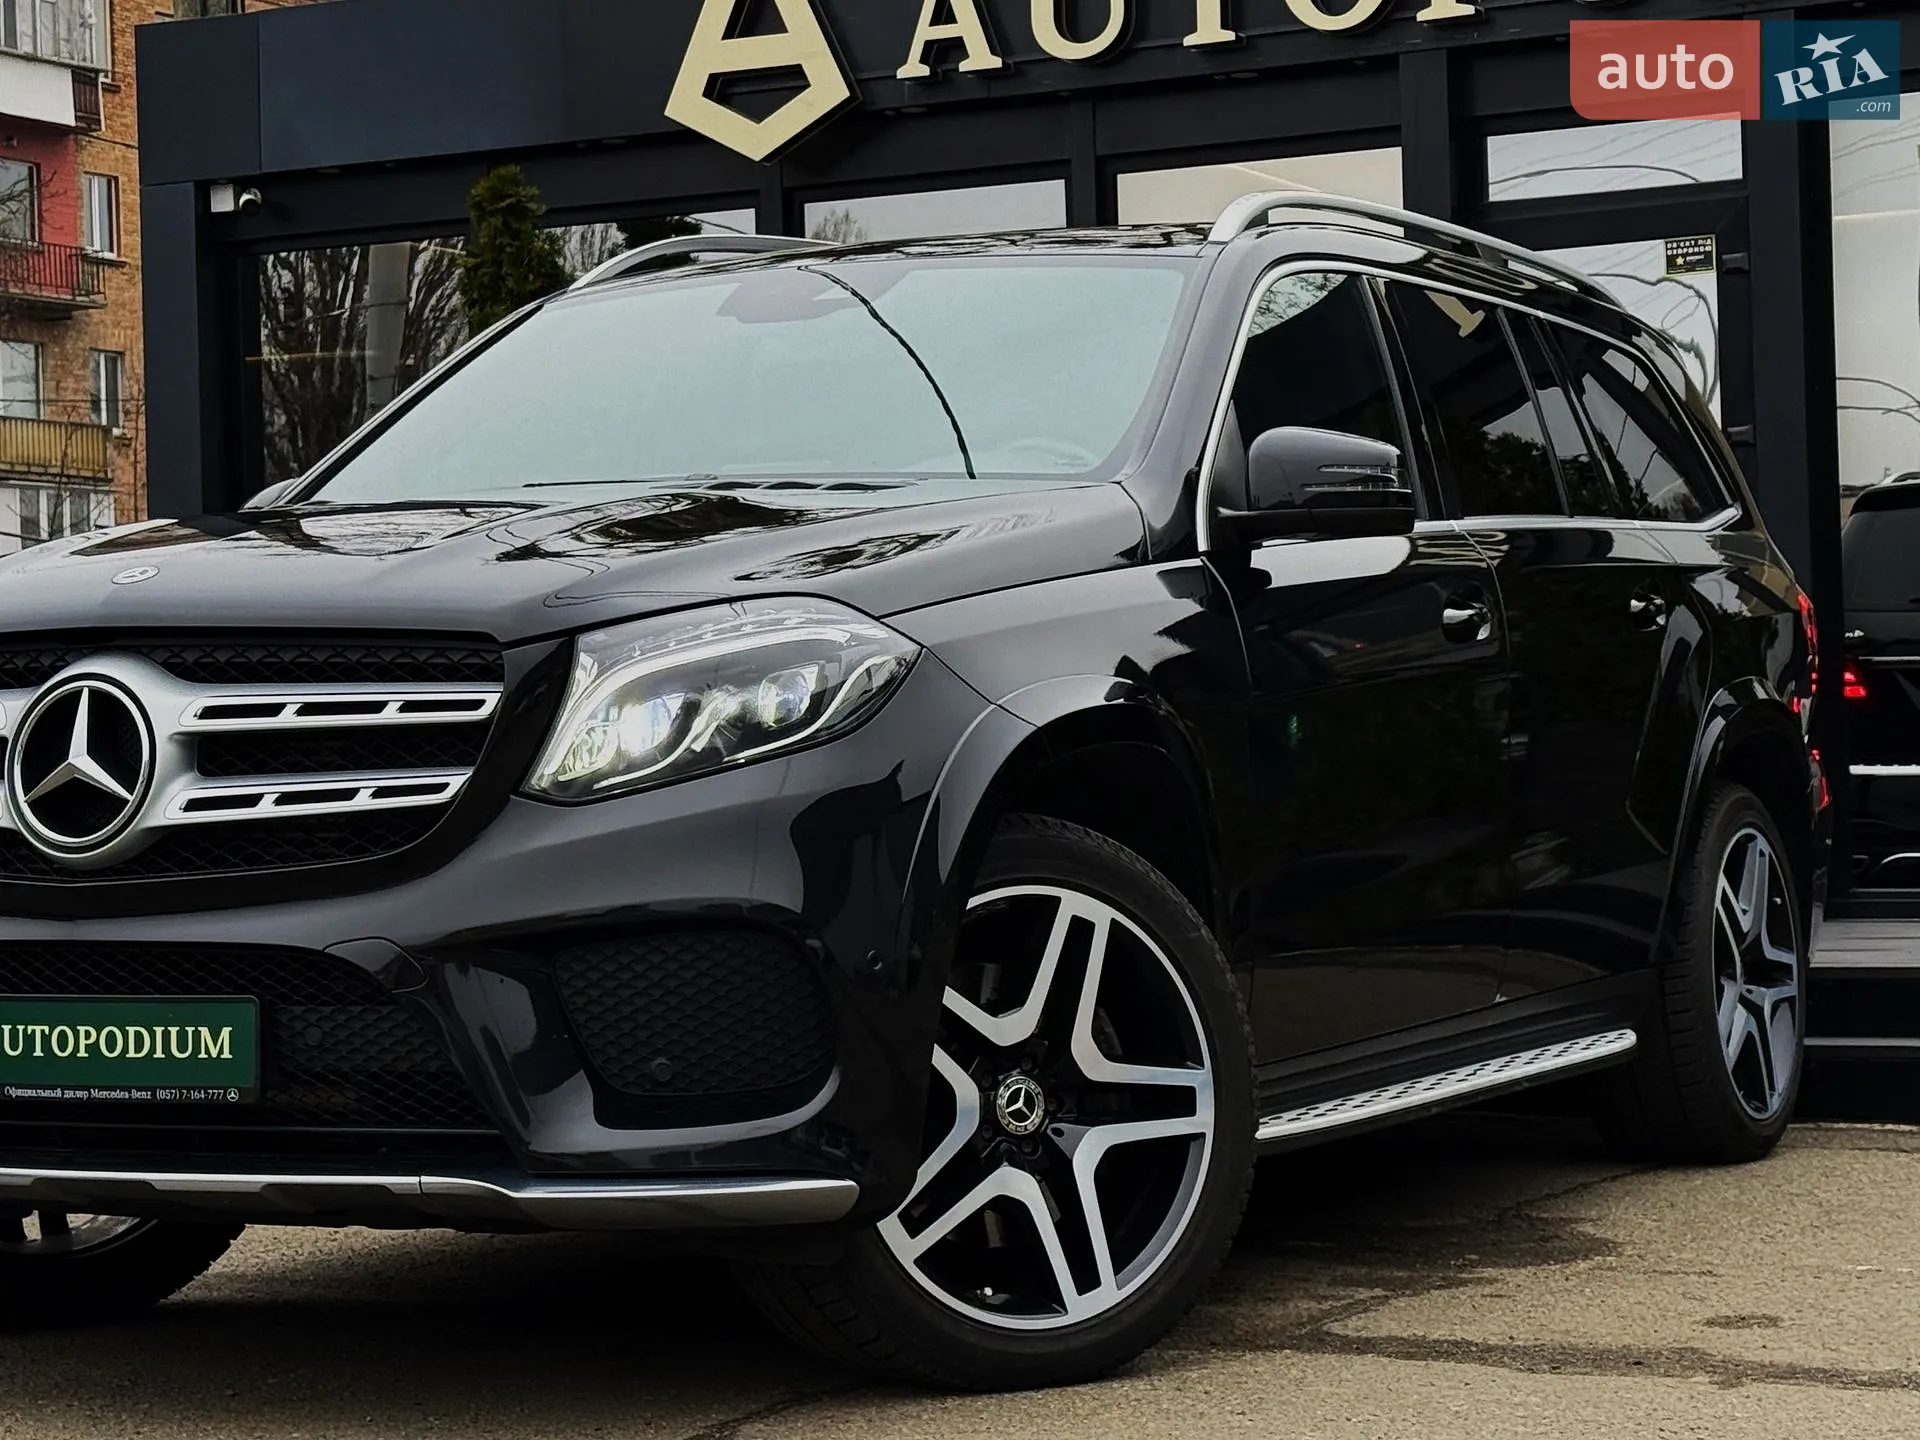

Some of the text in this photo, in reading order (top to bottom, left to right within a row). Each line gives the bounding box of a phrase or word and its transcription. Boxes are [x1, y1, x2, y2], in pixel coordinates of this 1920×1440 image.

[0, 1025, 233, 1058] UTOPODIUM
[90, 1088, 152, 1099] Mercedes-Benz
[156, 1088, 180, 1100] (057)
[182, 1089, 224, 1099] 7-164-777
